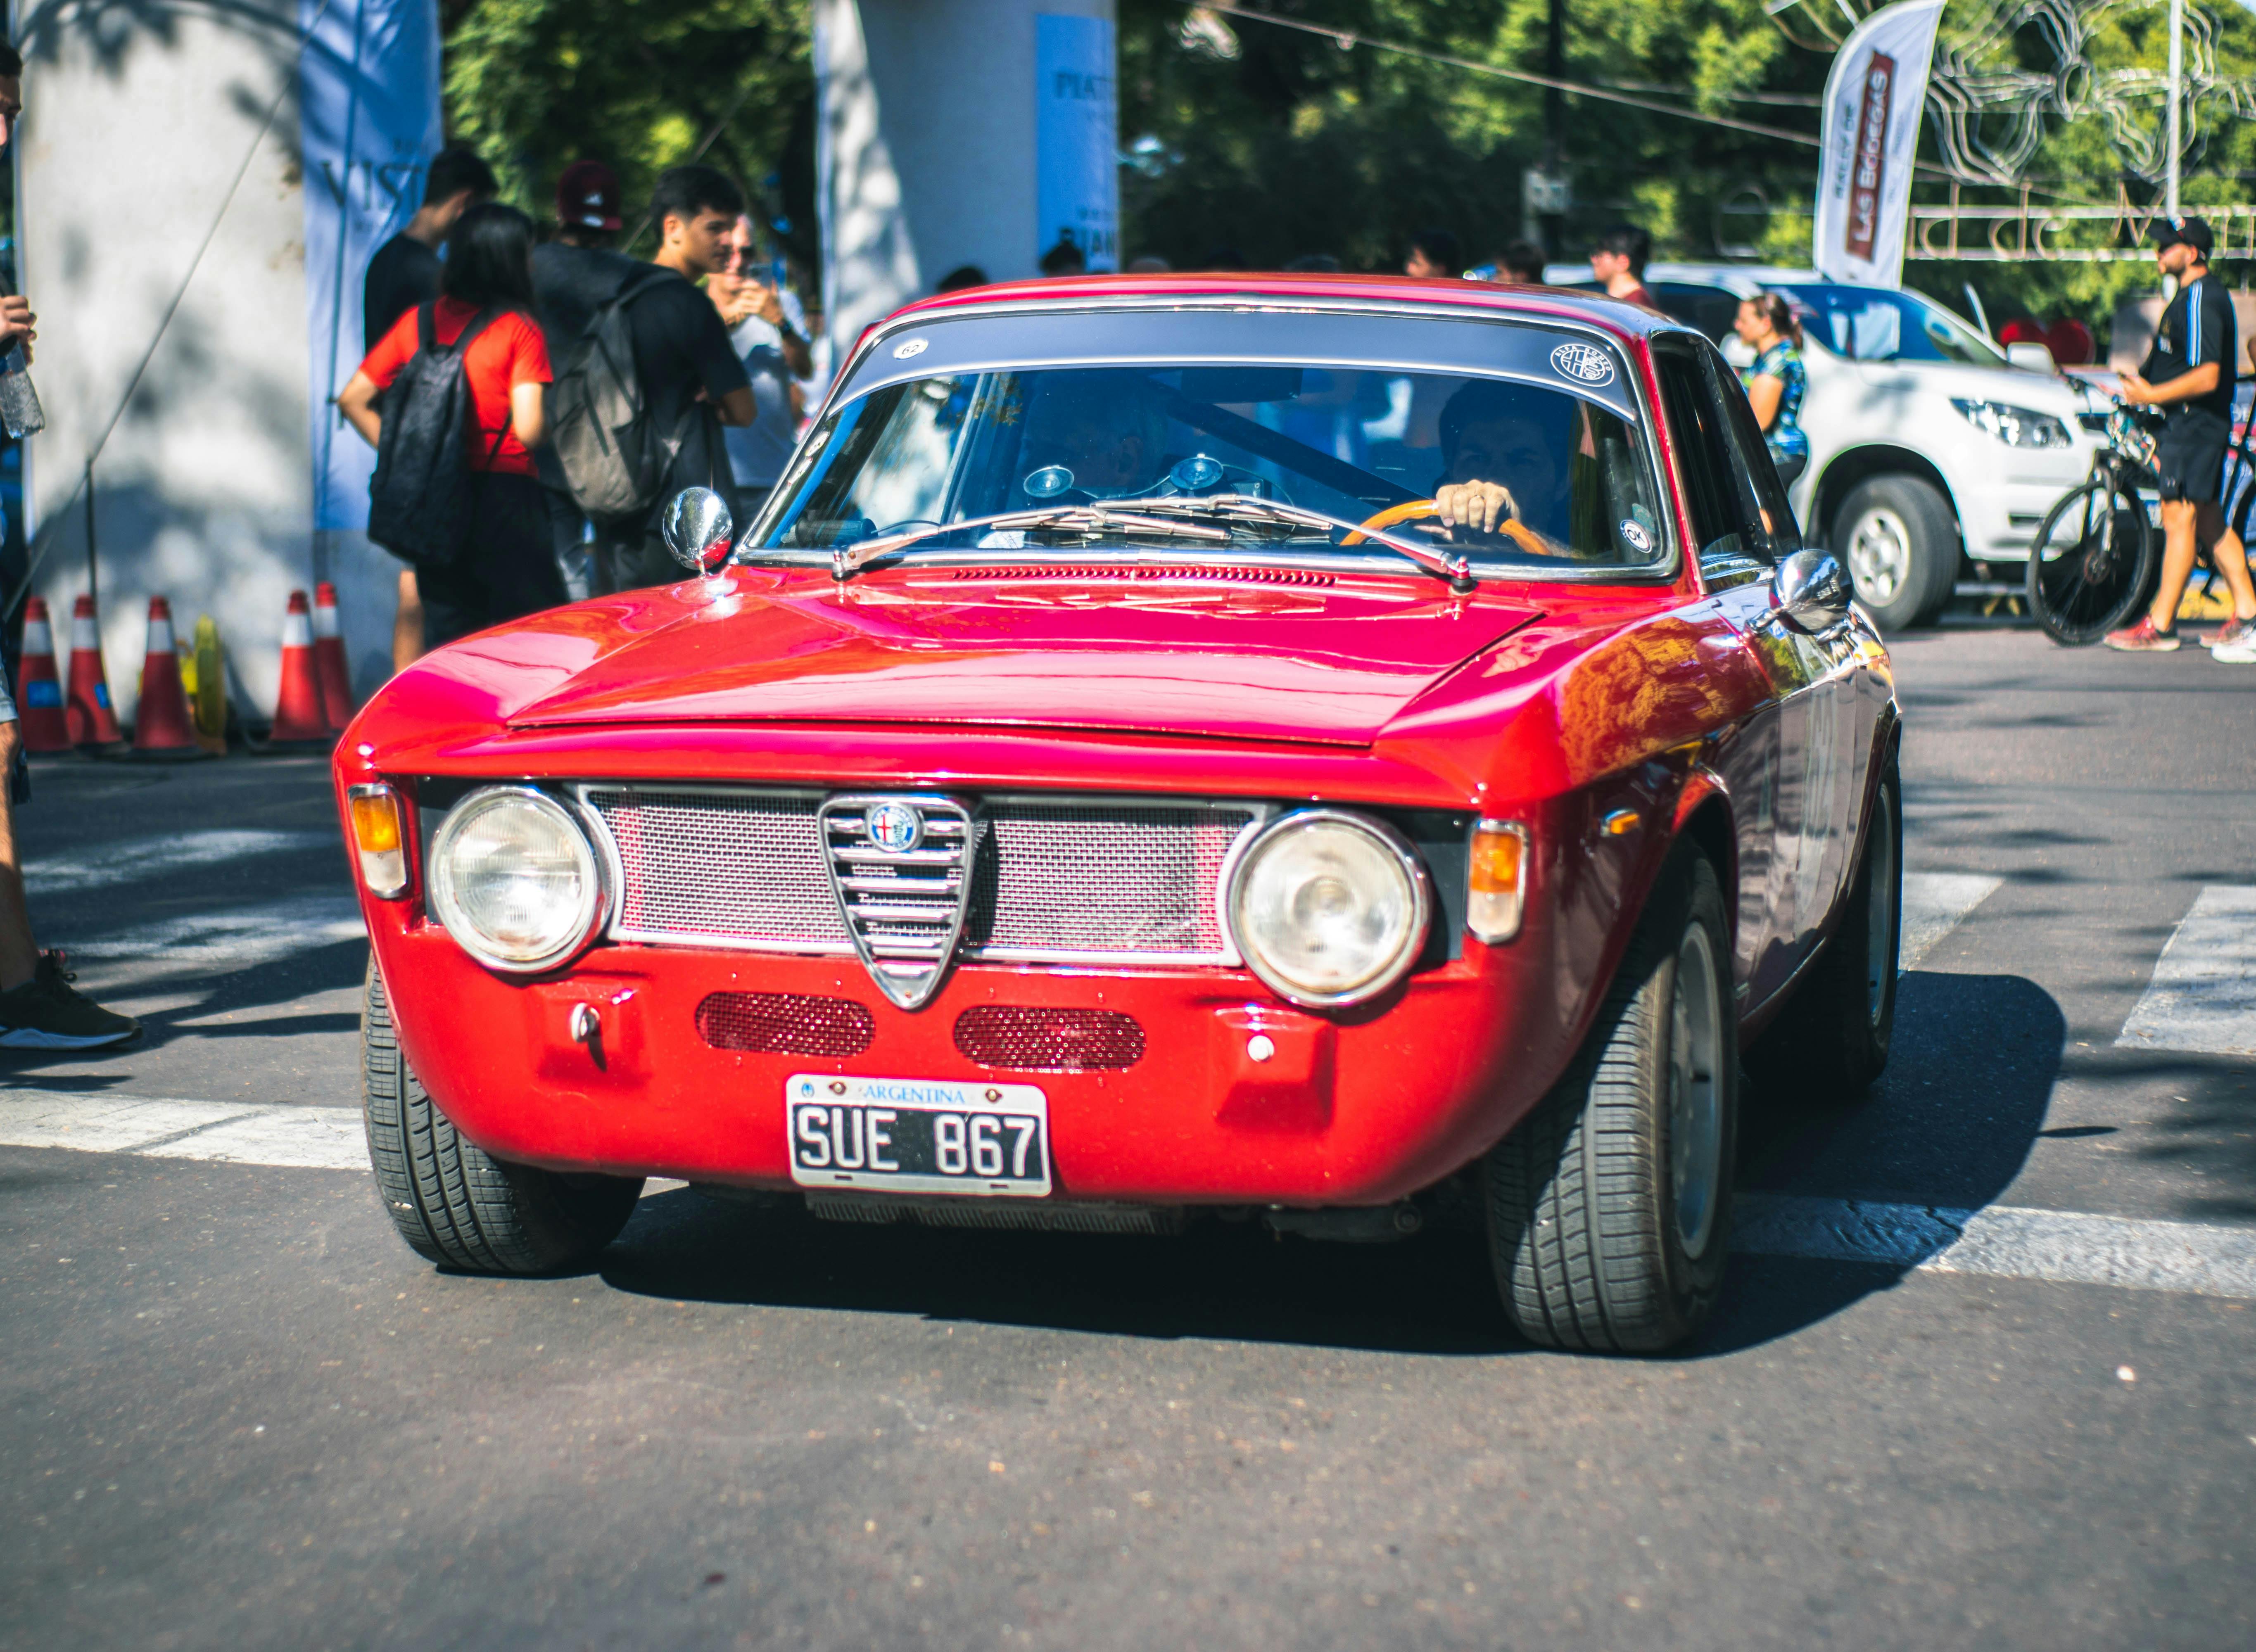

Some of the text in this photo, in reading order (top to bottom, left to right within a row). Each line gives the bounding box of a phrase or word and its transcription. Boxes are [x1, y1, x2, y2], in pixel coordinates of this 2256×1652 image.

[1853, 69, 1888, 242] LAS BODEGAS
[1555, 345, 1612, 371] ALFA ROMEO
[864, 1084, 965, 1104] ARGENTINA
[798, 1105, 1036, 1177] SUE 867
